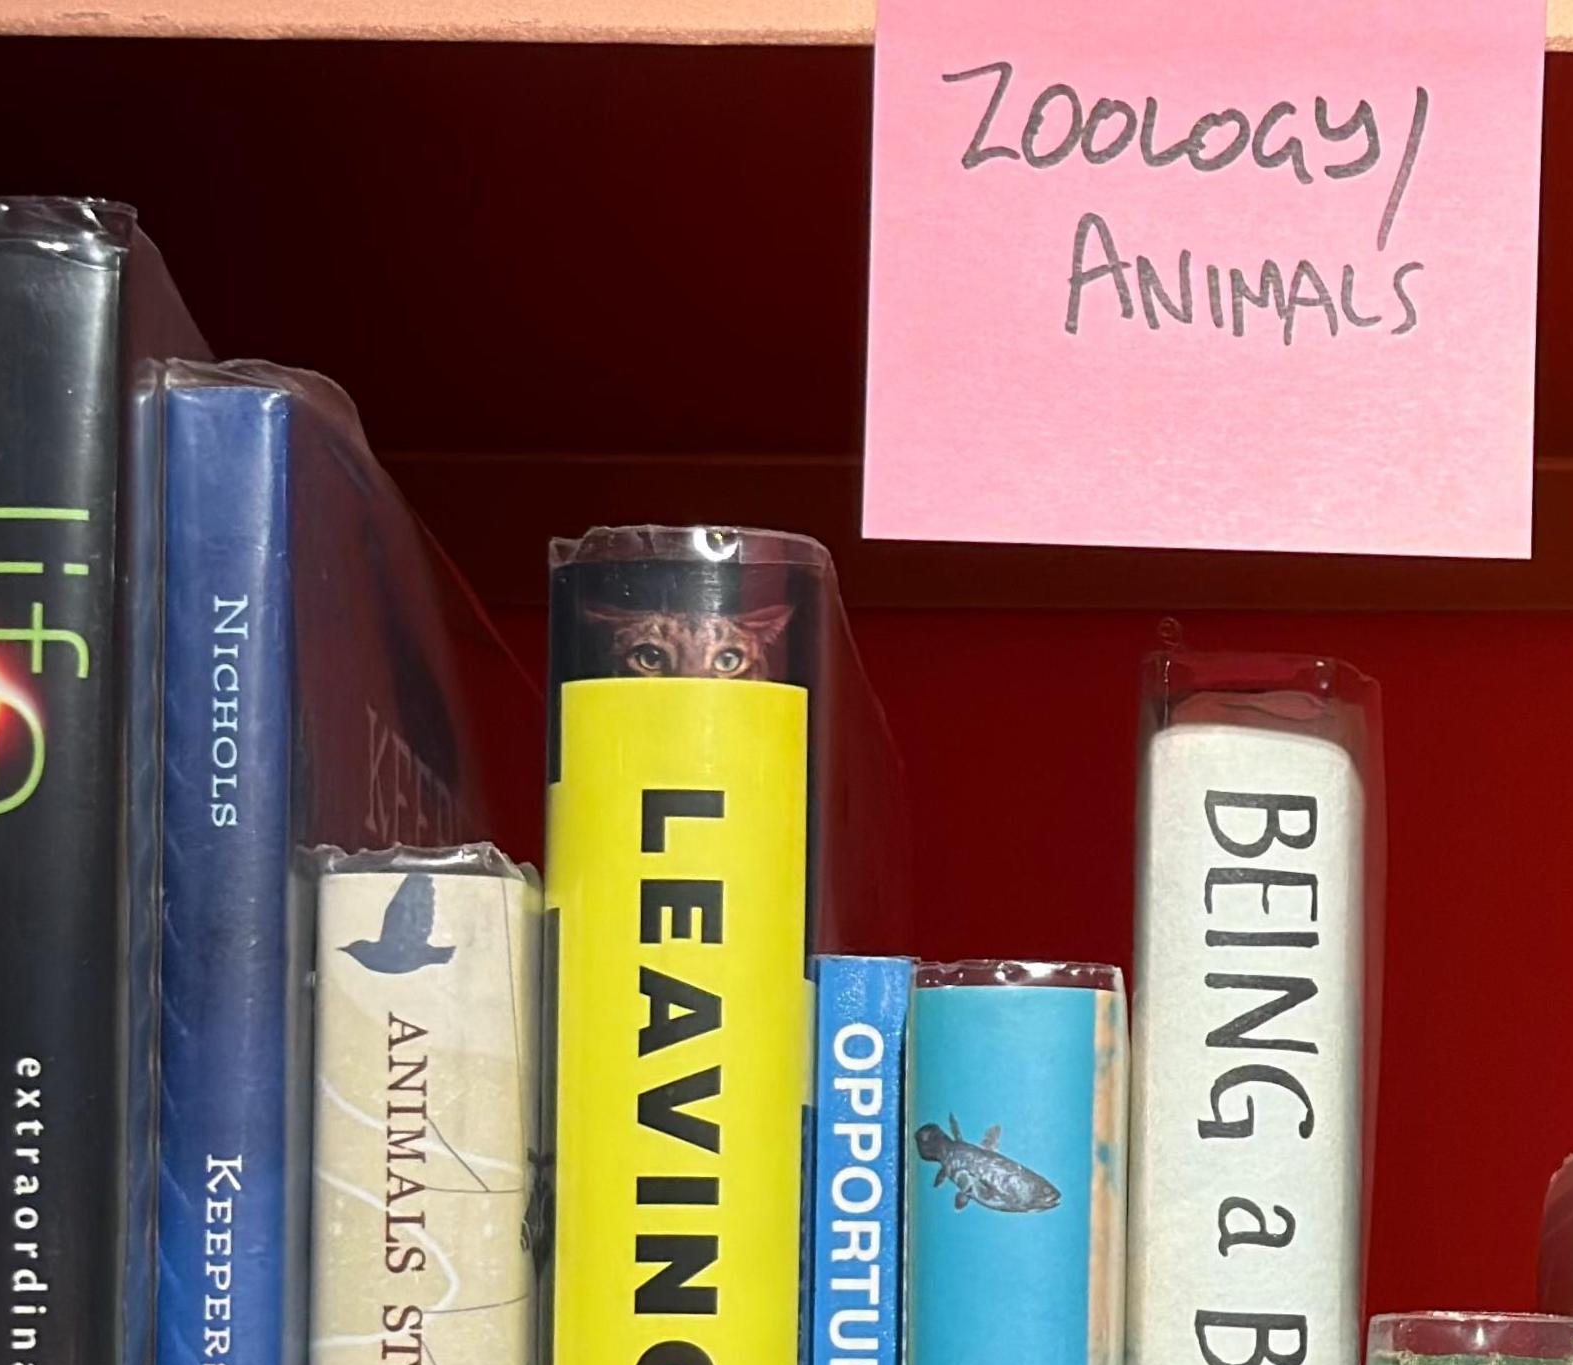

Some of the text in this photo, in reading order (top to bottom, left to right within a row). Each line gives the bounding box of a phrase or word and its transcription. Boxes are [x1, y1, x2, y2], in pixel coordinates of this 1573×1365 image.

[942, 60, 1428, 252] ZOOLOGY/
[1064, 212, 1425, 347] ANIMALS
[210, 594, 249, 827] NICHOLS
[1197, 789, 1320, 1140] BEING
[384, 1011, 428, 1275] ANIMALS
[1217, 1196, 1296, 1258] a
